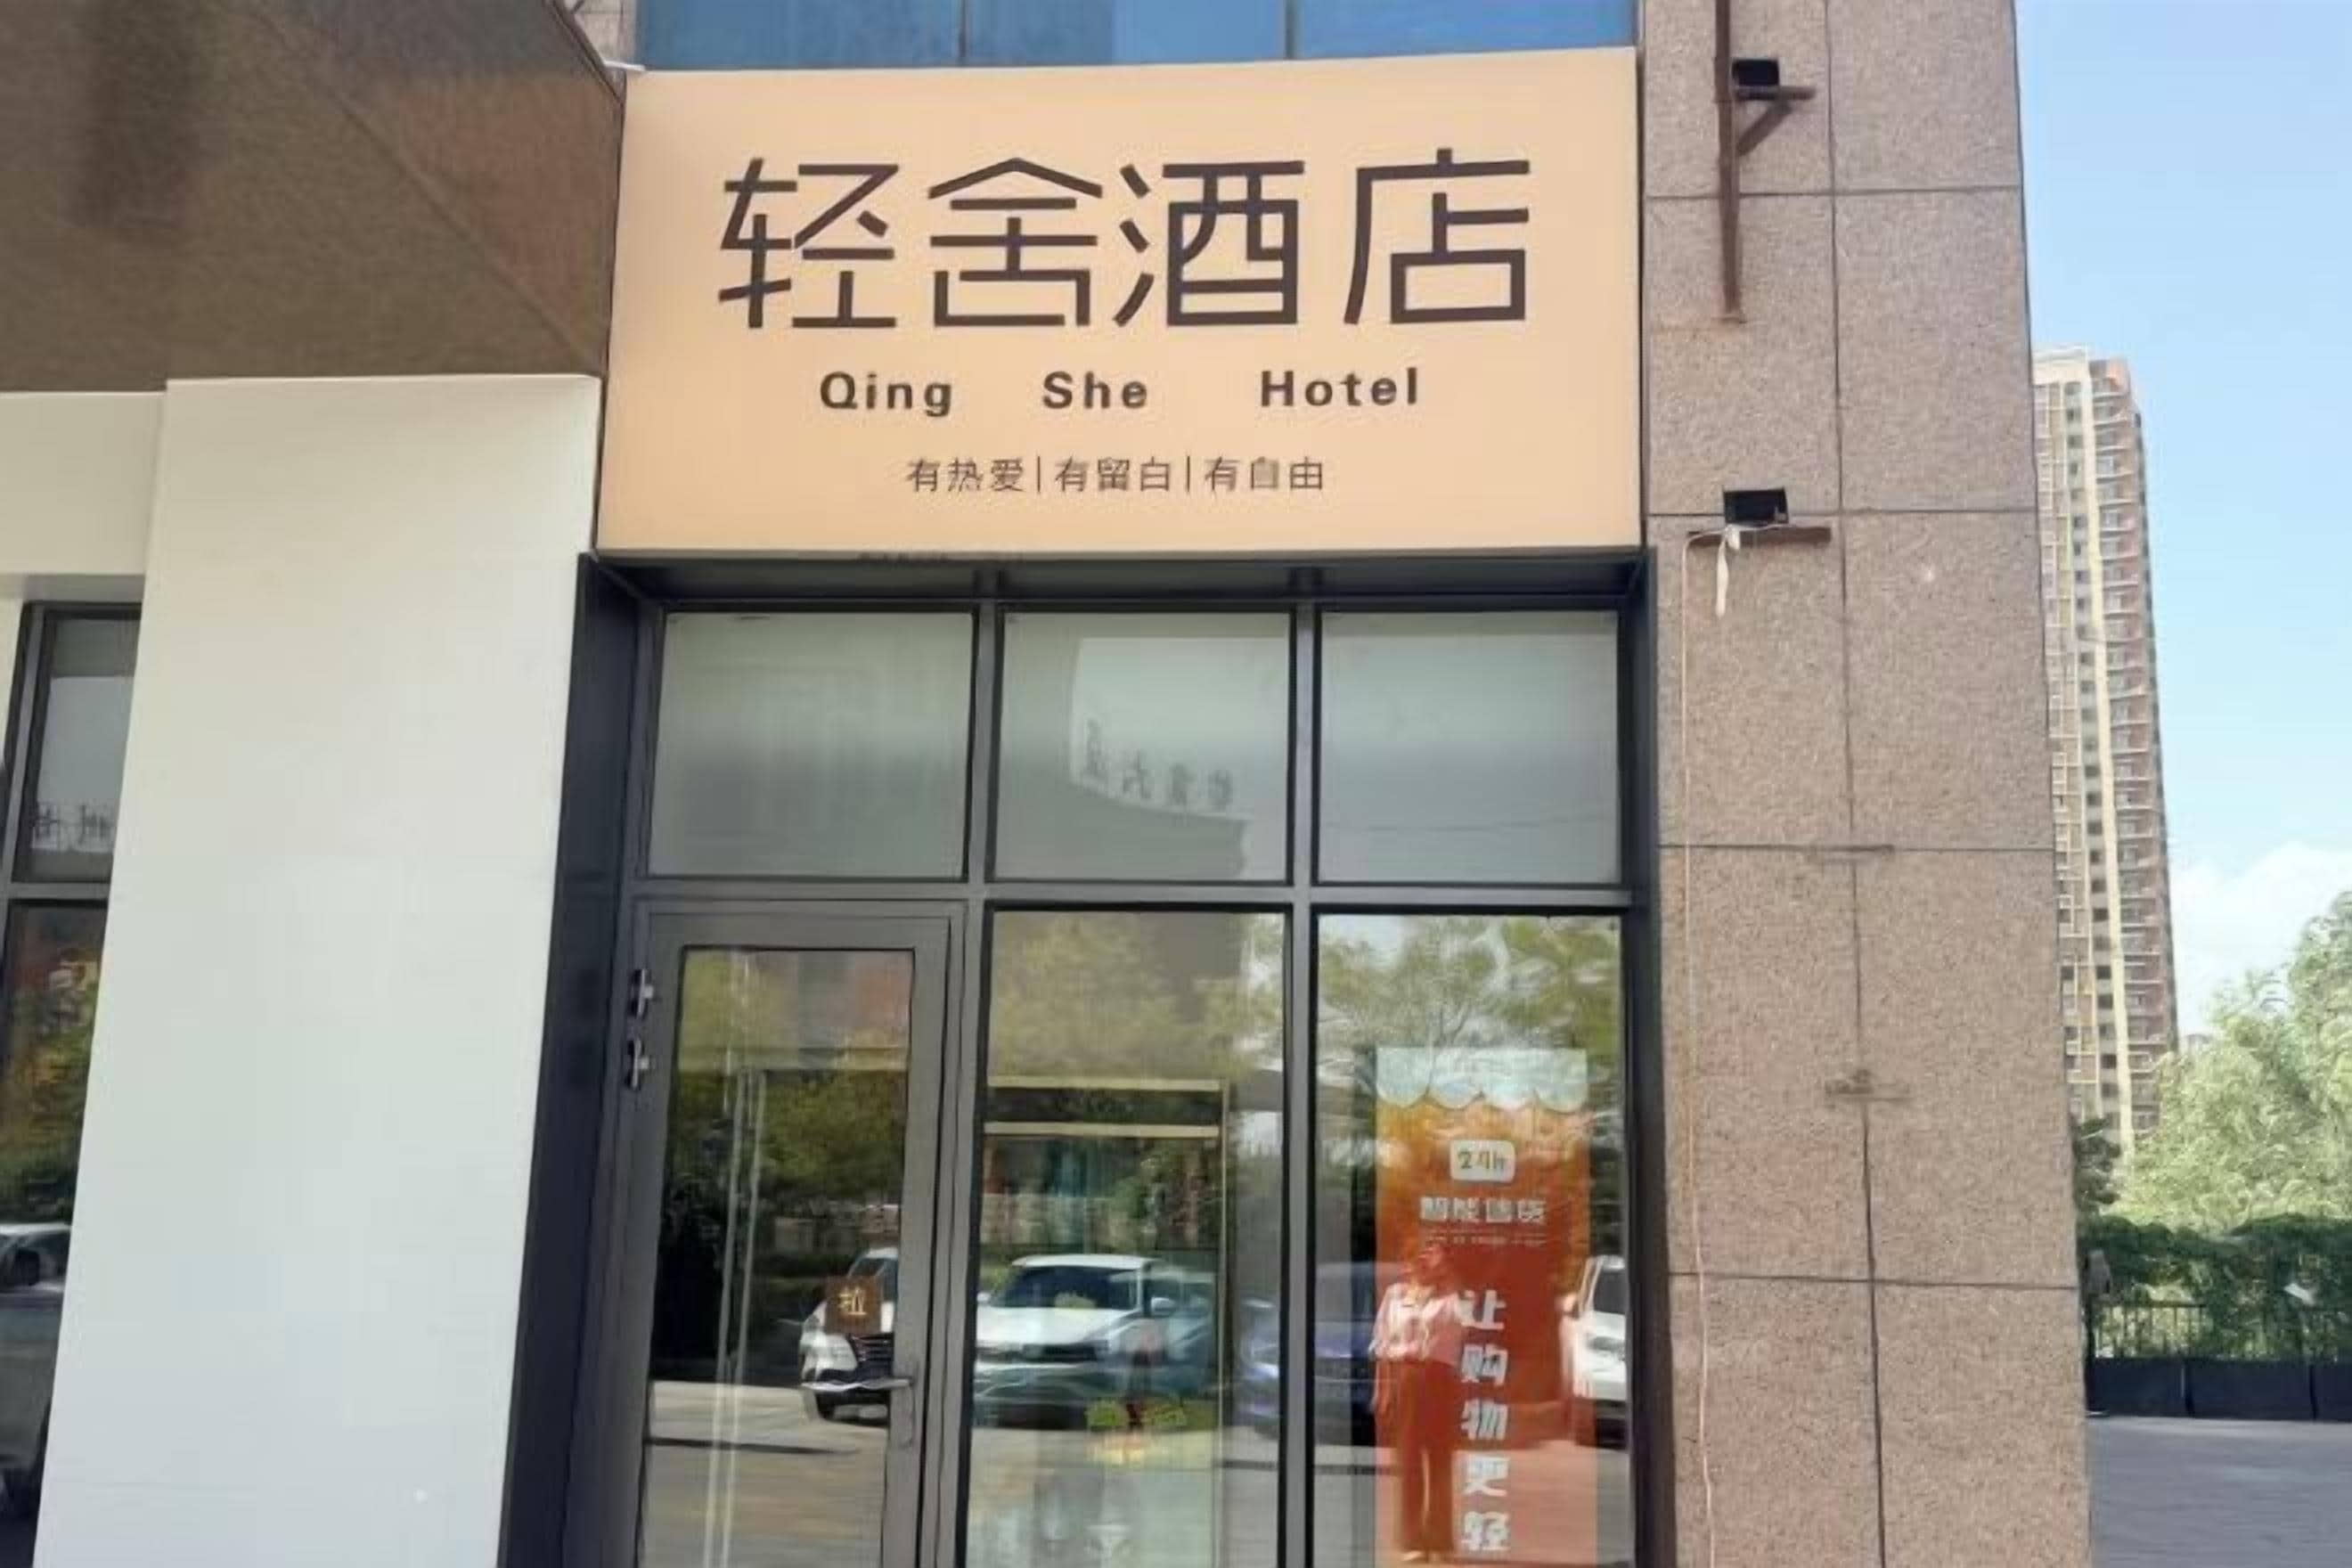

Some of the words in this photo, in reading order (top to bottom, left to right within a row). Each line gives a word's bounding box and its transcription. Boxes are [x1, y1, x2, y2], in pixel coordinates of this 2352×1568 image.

[718, 148, 1530, 329] 轻舍酒店
[820, 371, 952, 418] Qing
[1042, 371, 1147, 409] She
[1261, 366, 1418, 408] Hotel
